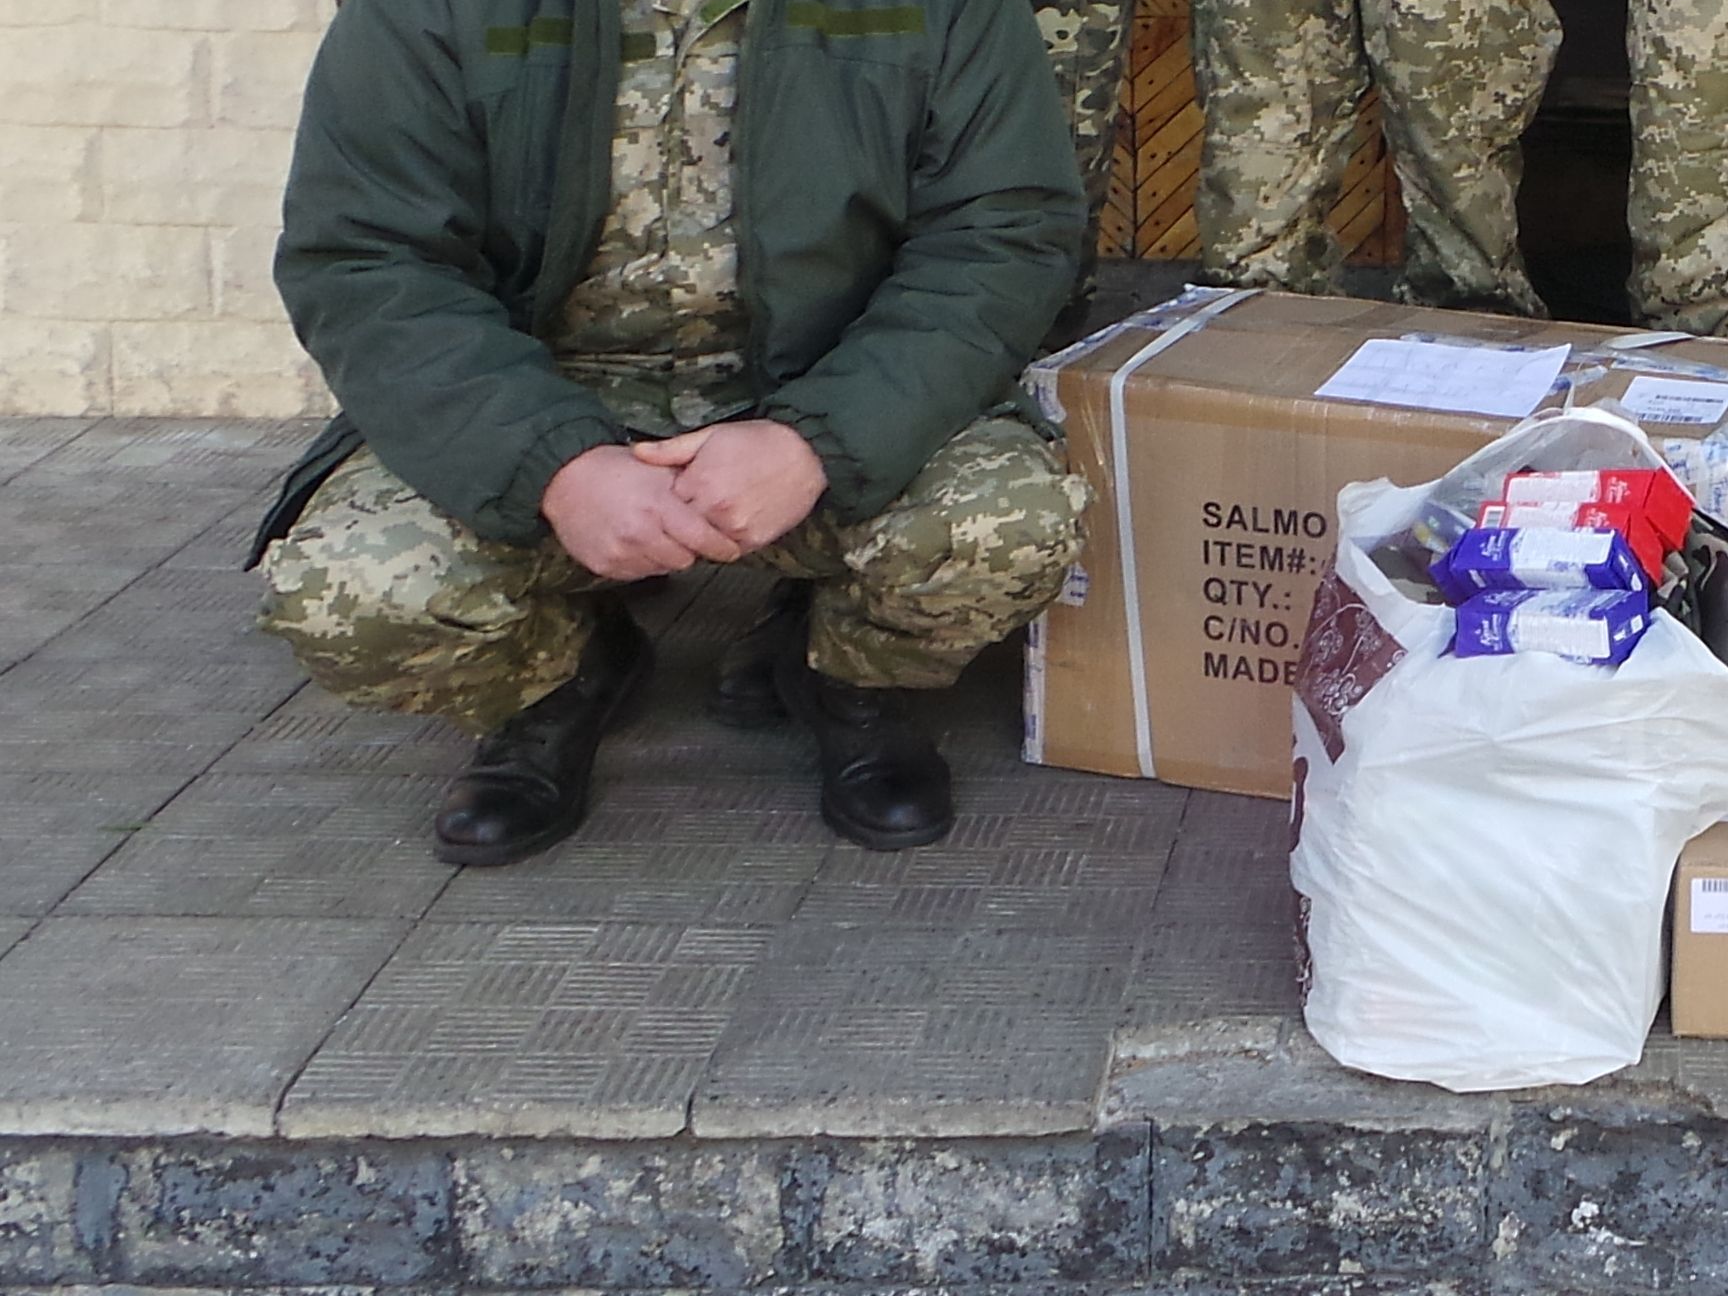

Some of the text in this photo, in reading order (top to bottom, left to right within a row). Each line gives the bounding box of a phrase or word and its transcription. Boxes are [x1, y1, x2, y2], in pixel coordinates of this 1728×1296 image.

[1202, 501, 1327, 538] SALMO
[1203, 540, 1316, 575] ITEM#:
[1203, 577, 1291, 611] QTY.:
[1204, 615, 1299, 650] C/NO.
[1204, 651, 1298, 687] MADE
